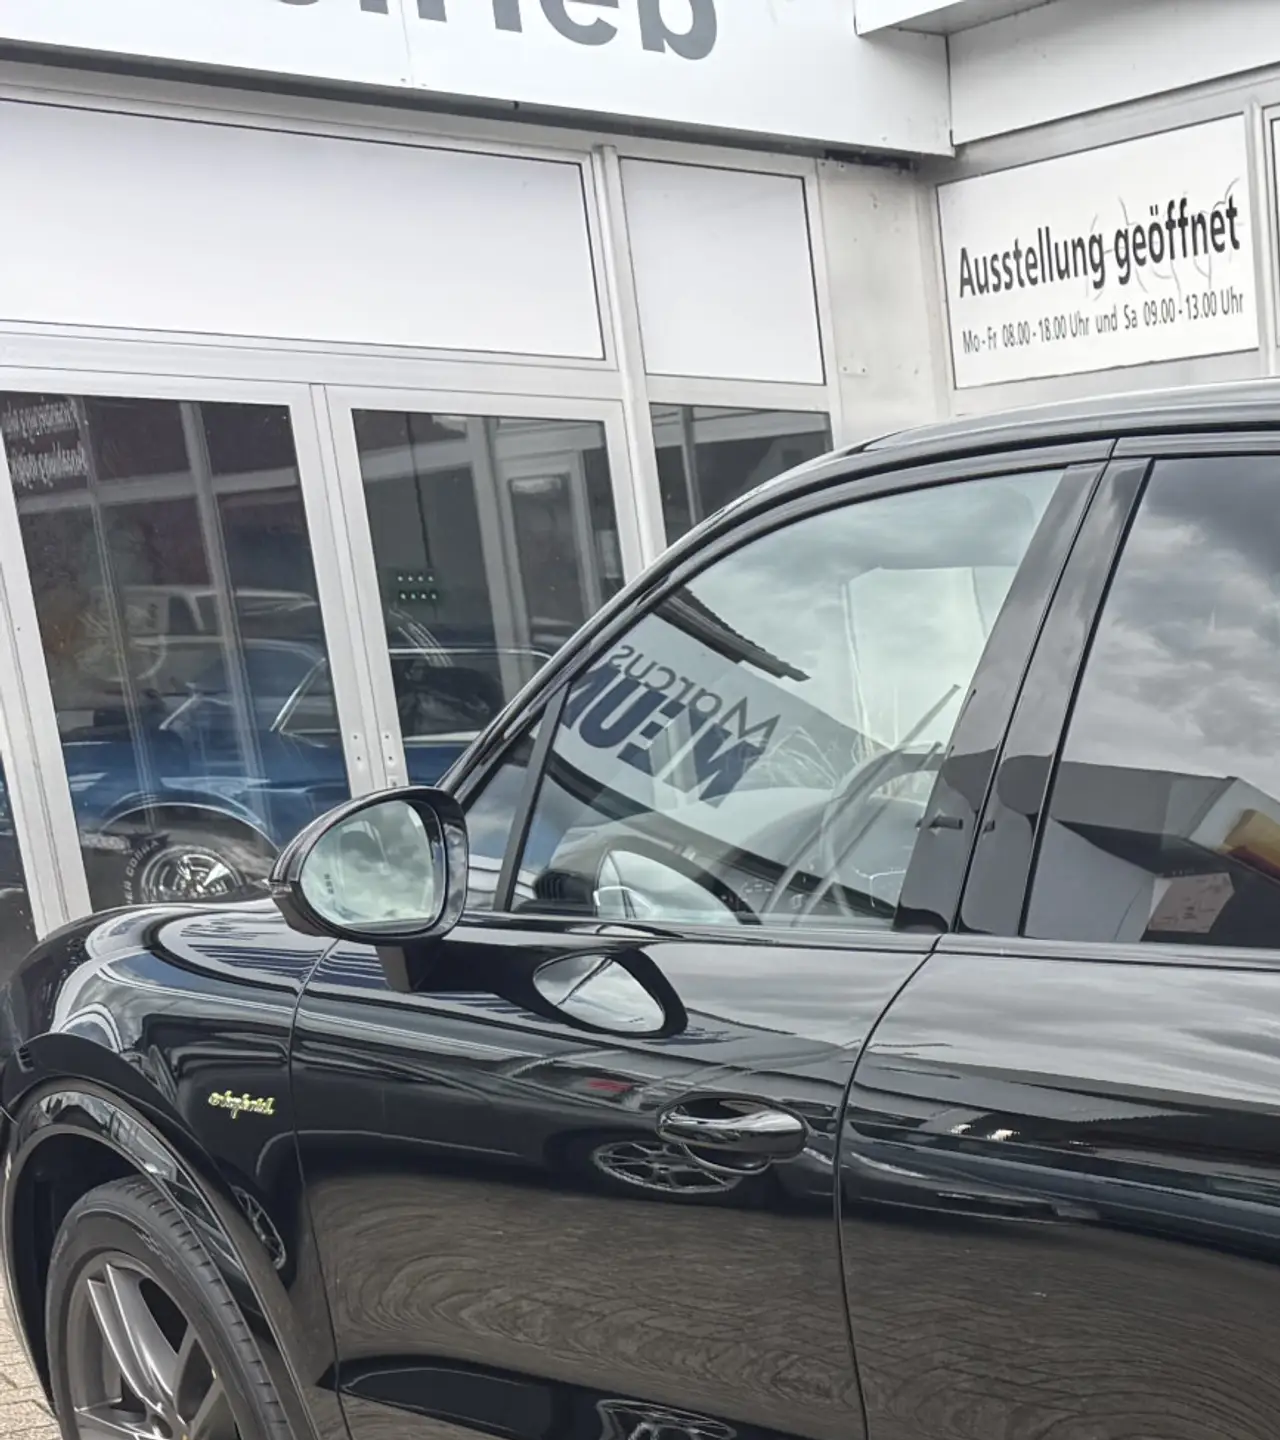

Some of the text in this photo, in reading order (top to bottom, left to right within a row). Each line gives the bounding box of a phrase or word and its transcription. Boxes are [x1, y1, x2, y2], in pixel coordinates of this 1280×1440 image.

[959, 196, 1240, 298] Ausstellung geöffnet
[1002, 320, 1030, 347] 08.00
[1039, 314, 1067, 341] 18.00
[1070, 310, 1090, 336] Uhr
[1095, 305, 1118, 333] und
[1124, 303, 1138, 329] Sa
[1143, 298, 1176, 326] 09.00
[1185, 291, 1218, 320] 13.00
[1221, 286, 1244, 315] Uhr
